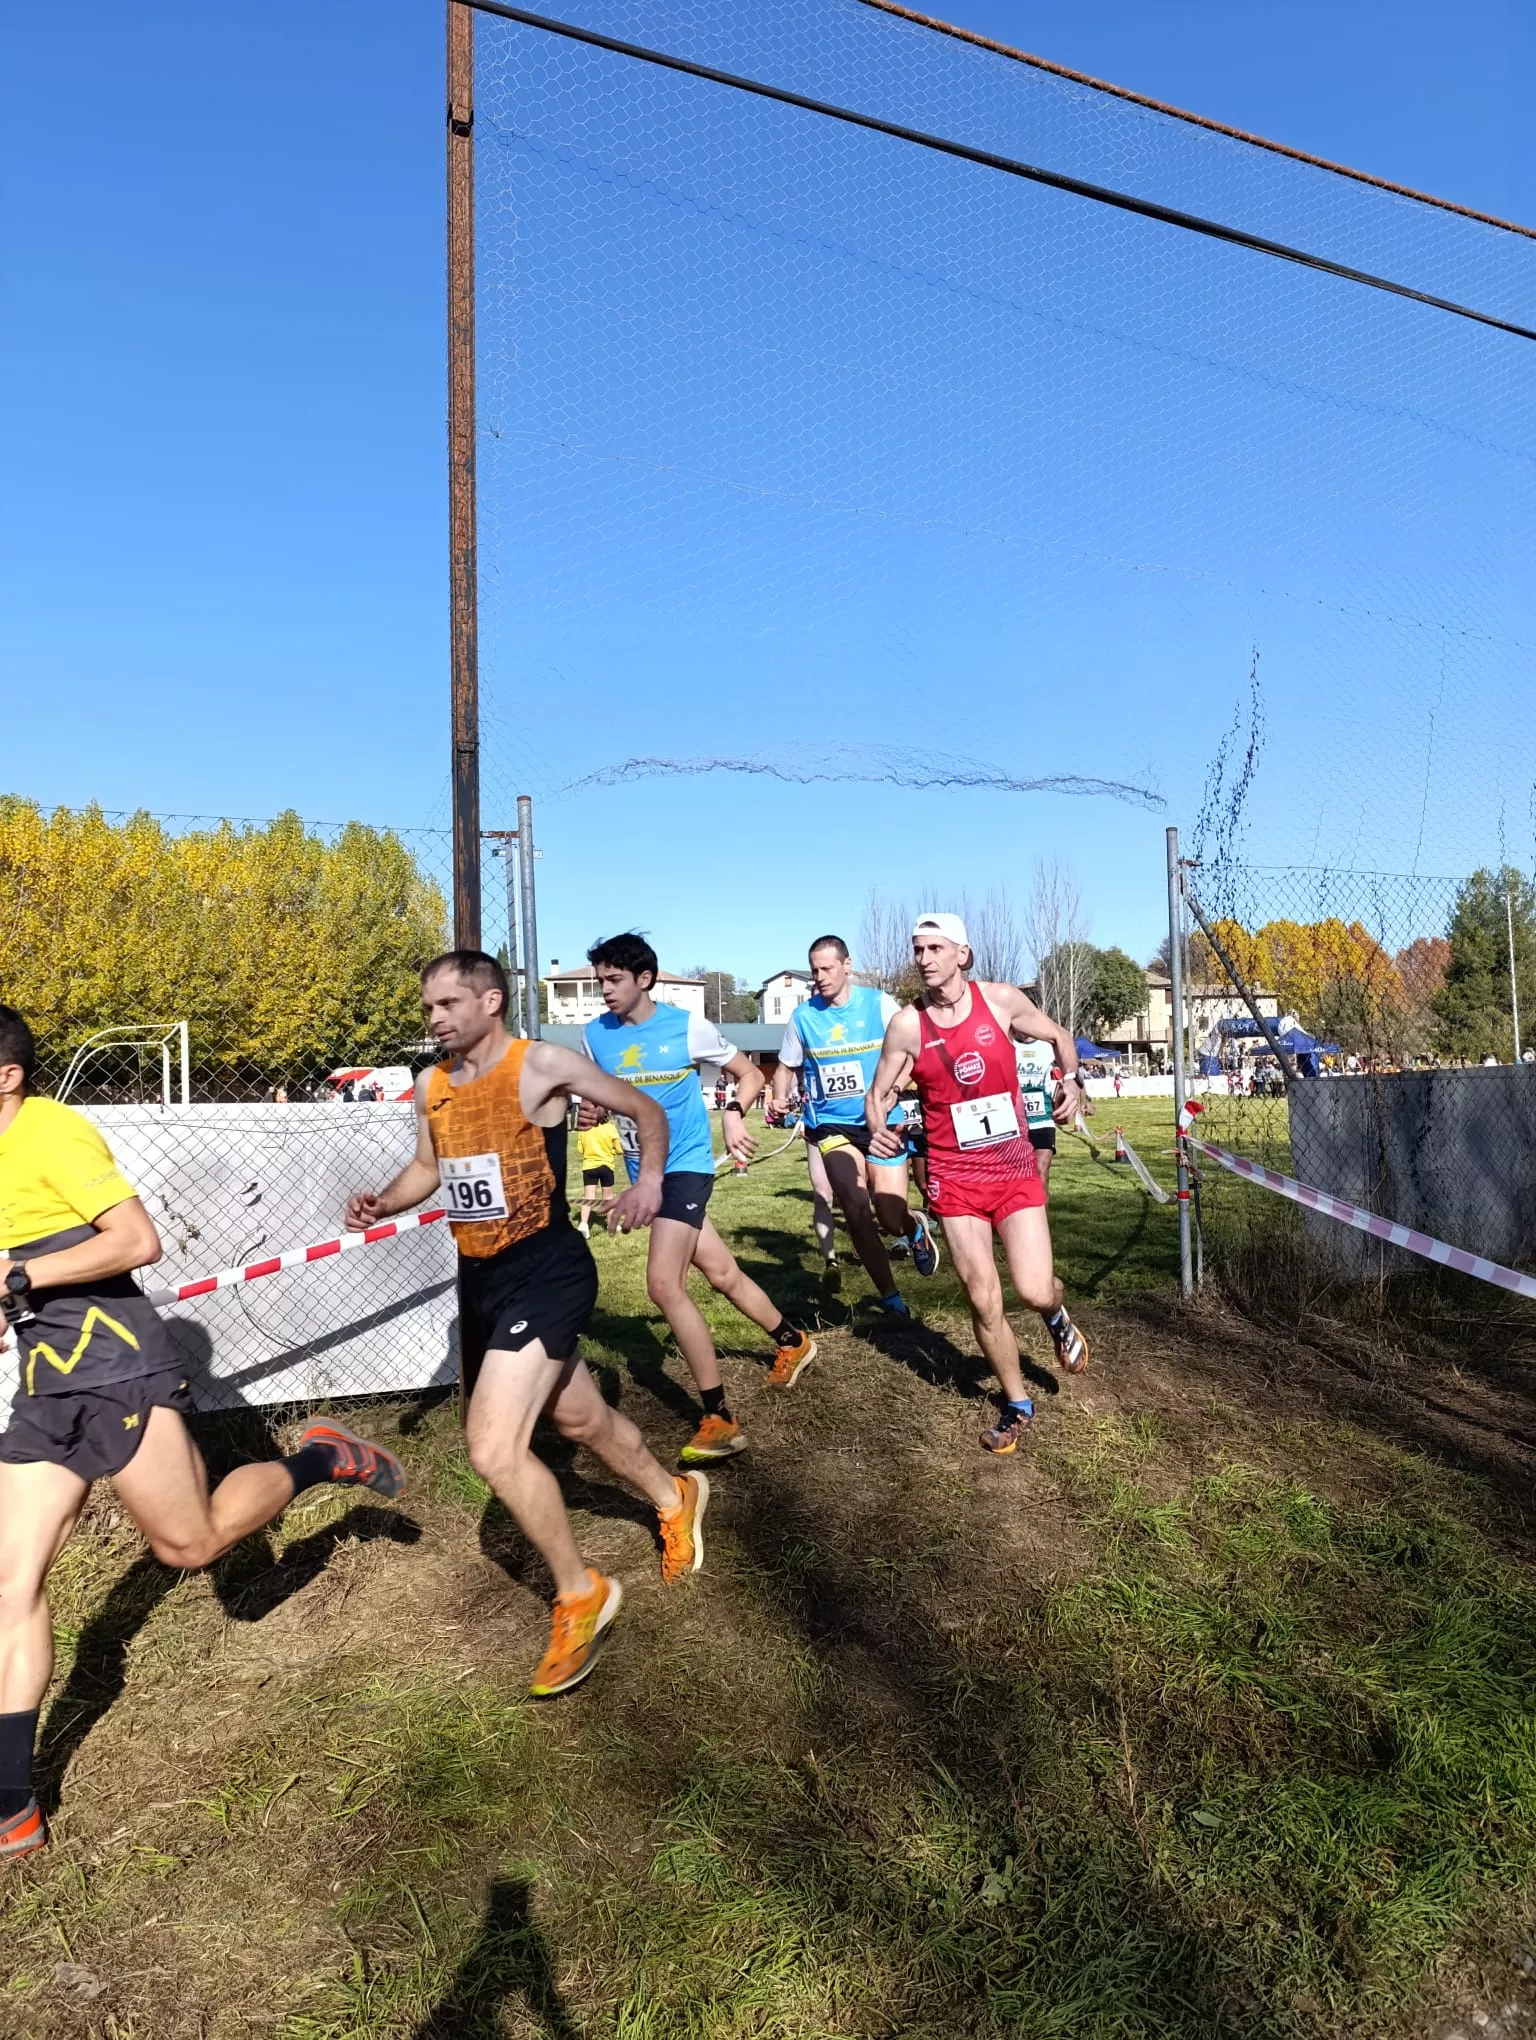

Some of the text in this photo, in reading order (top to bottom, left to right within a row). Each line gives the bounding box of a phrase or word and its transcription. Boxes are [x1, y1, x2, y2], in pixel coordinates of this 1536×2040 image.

[826, 1074, 857, 1092] 235
[1024, 1101, 1040, 1112] 67
[979, 1115, 991, 1135] 1
[447, 1179, 492, 1209] 196
